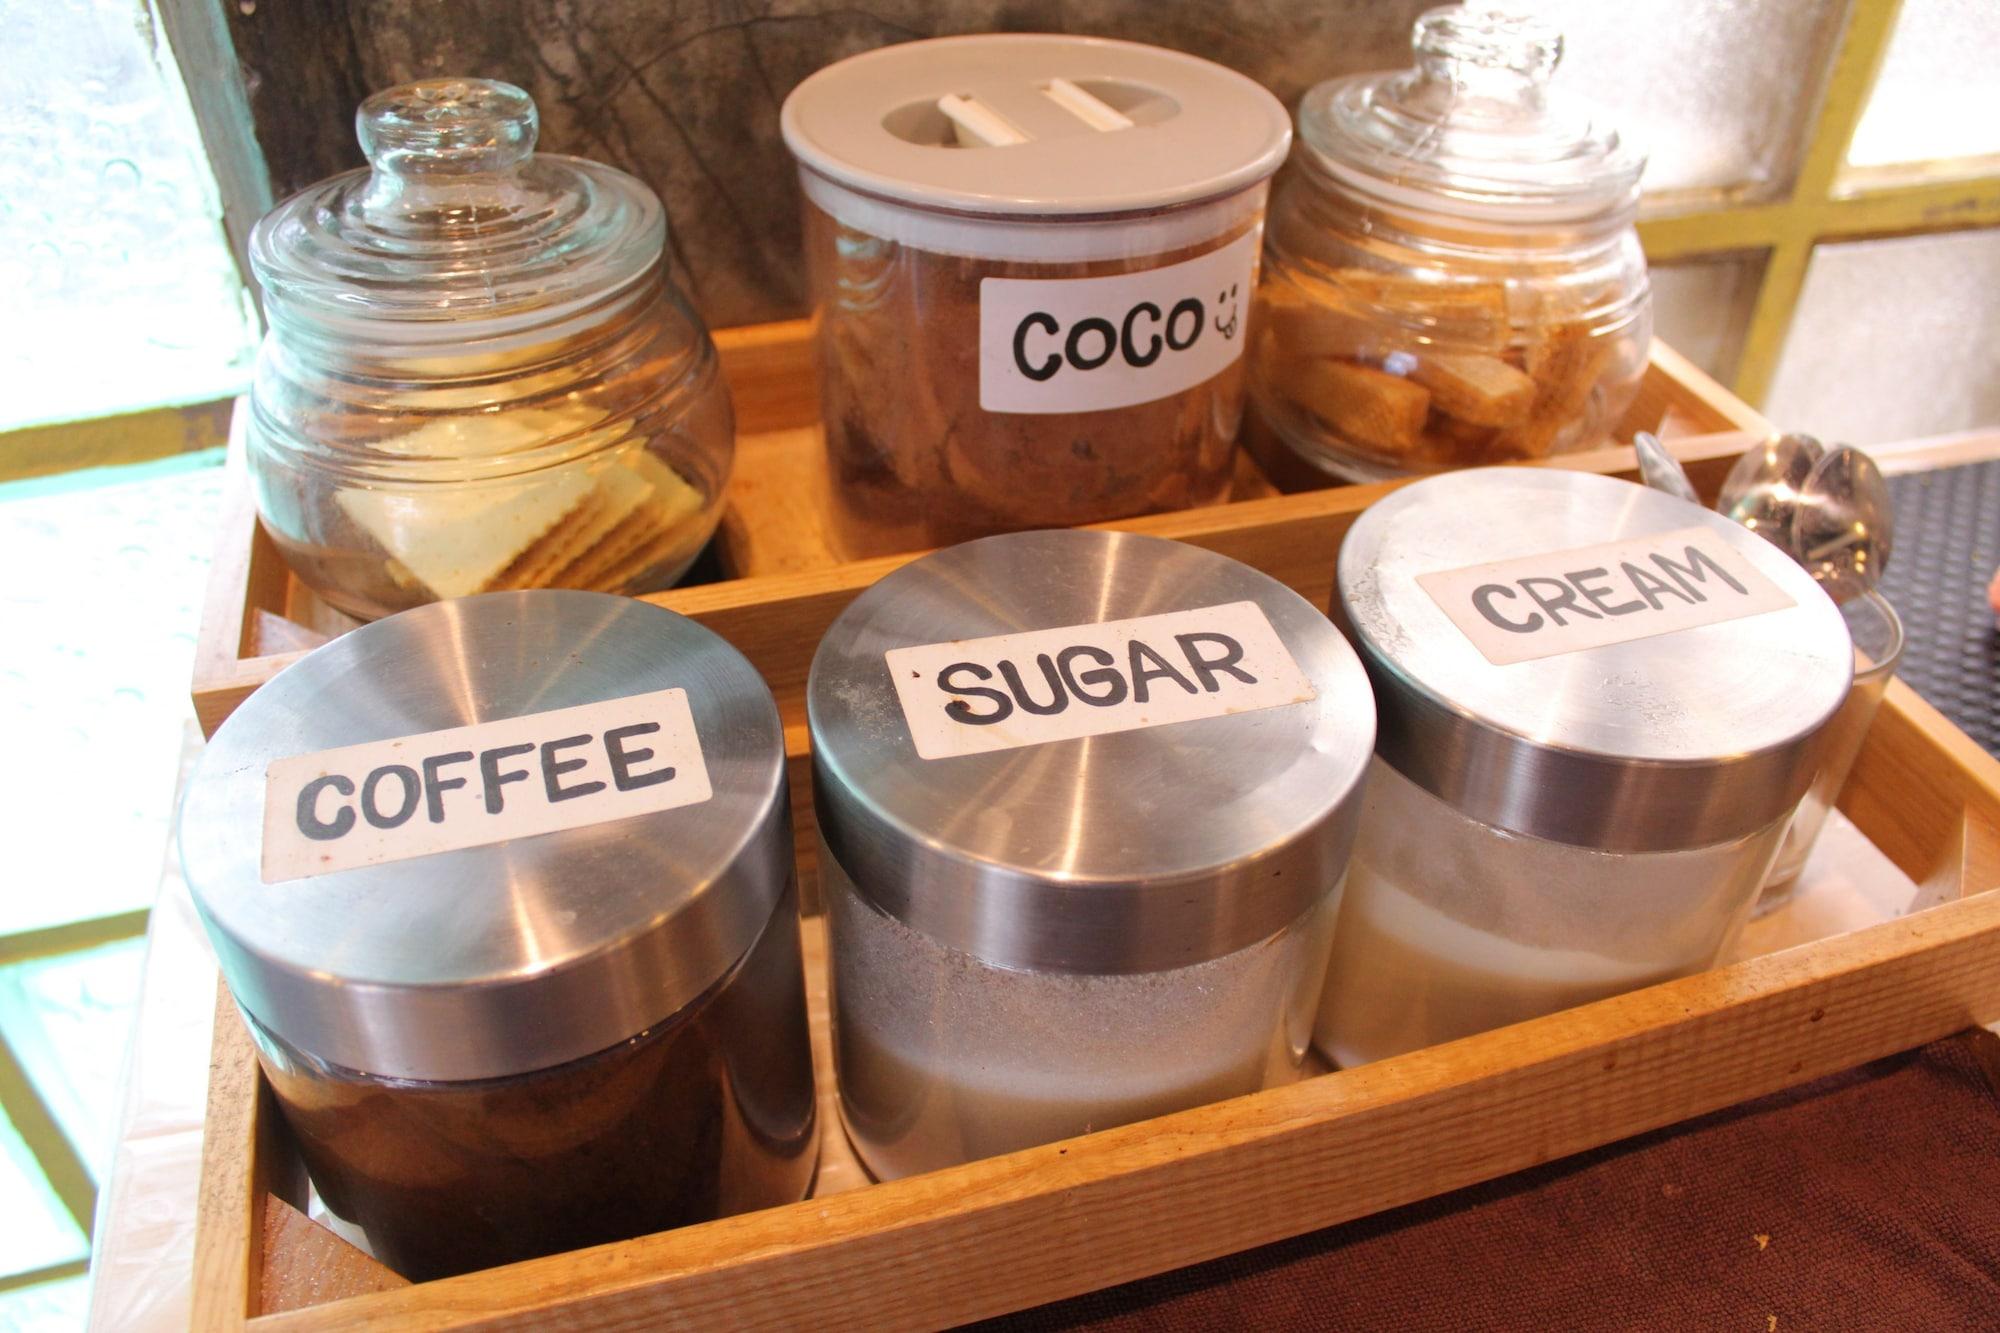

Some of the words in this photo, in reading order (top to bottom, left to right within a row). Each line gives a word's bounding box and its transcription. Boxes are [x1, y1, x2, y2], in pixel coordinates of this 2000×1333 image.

[1471, 544, 1749, 635] CREAM
[937, 632, 1258, 726] SUGAR
[296, 721, 677, 842] COFFEE
